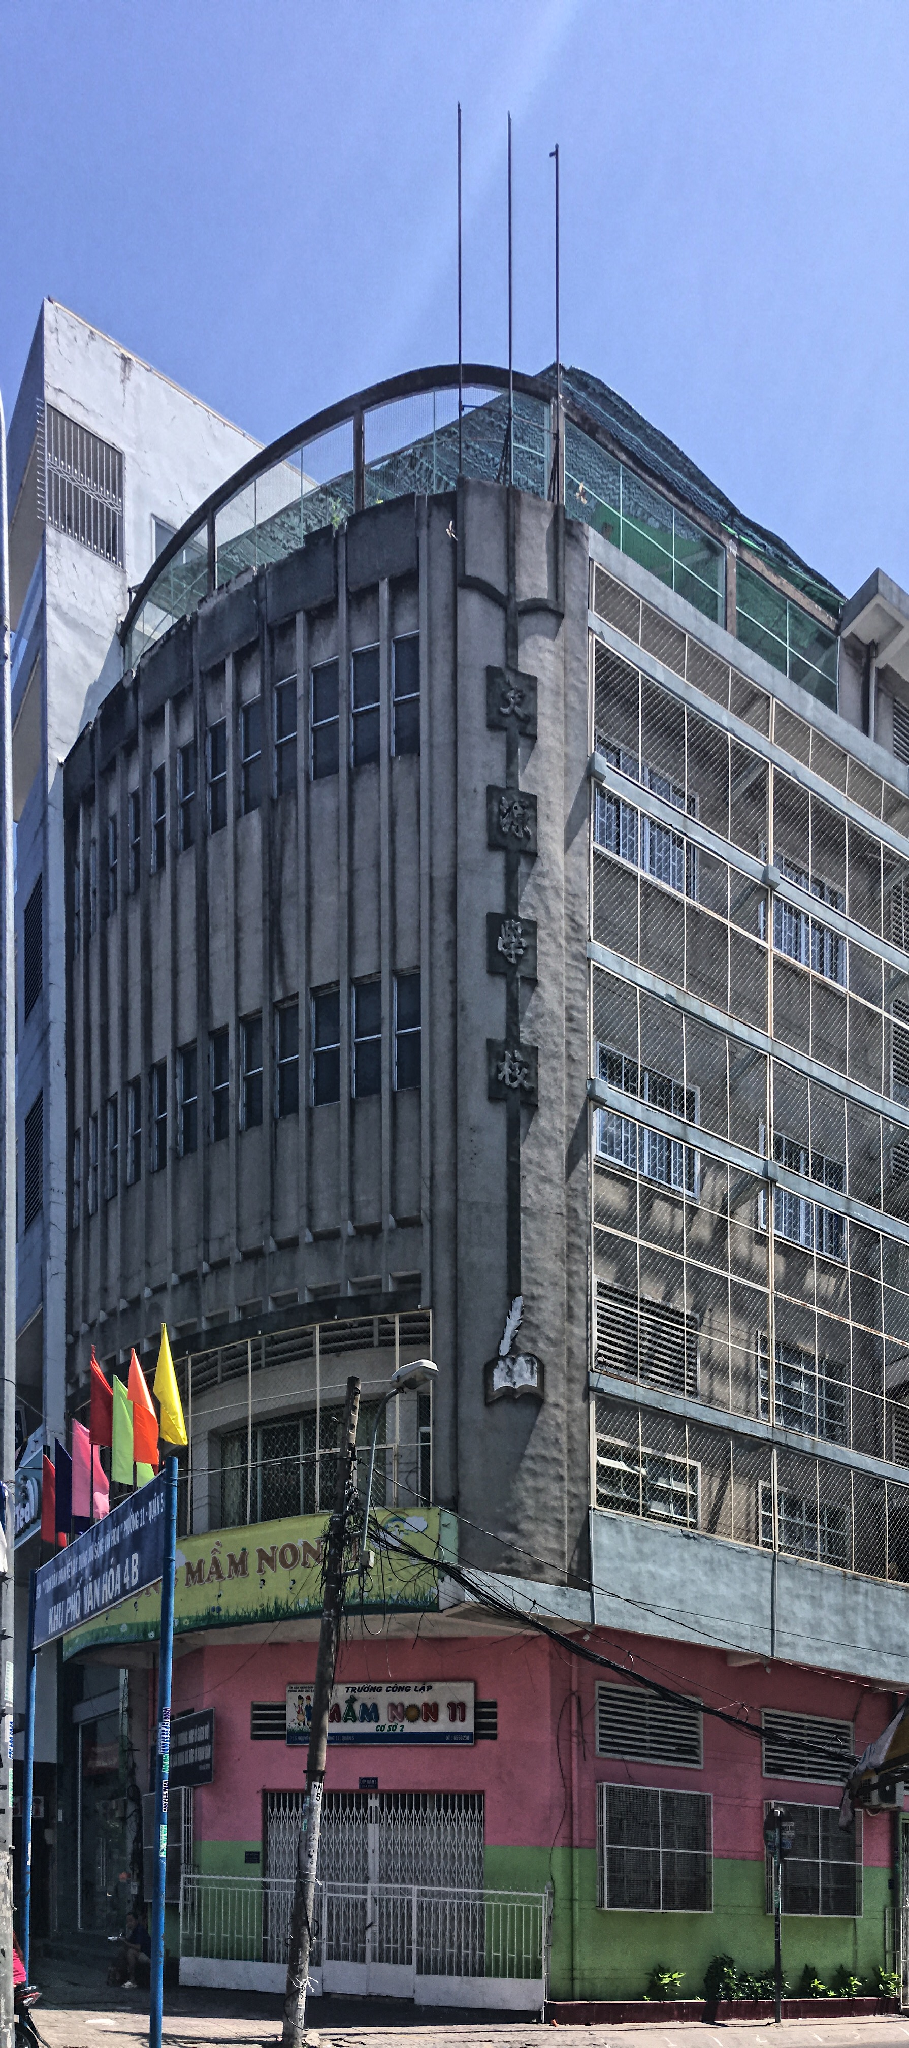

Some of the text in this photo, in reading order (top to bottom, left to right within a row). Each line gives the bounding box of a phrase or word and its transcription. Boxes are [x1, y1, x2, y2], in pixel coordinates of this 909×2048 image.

[184, 1540, 250, 1588] MẦM
[256, 1538, 324, 1575] NON
[49, 1601, 64, 1634] KHU
[66, 1577, 83, 1625] PHỐ
[84, 1576, 100, 1614] VĂN
[102, 1557, 120, 1604] HÓA
[345, 1683, 433, 1694] TRƯỜNG CÔNG LẬP
[447, 1701, 466, 1723] 11
[399, 1724, 405, 1732] 2
